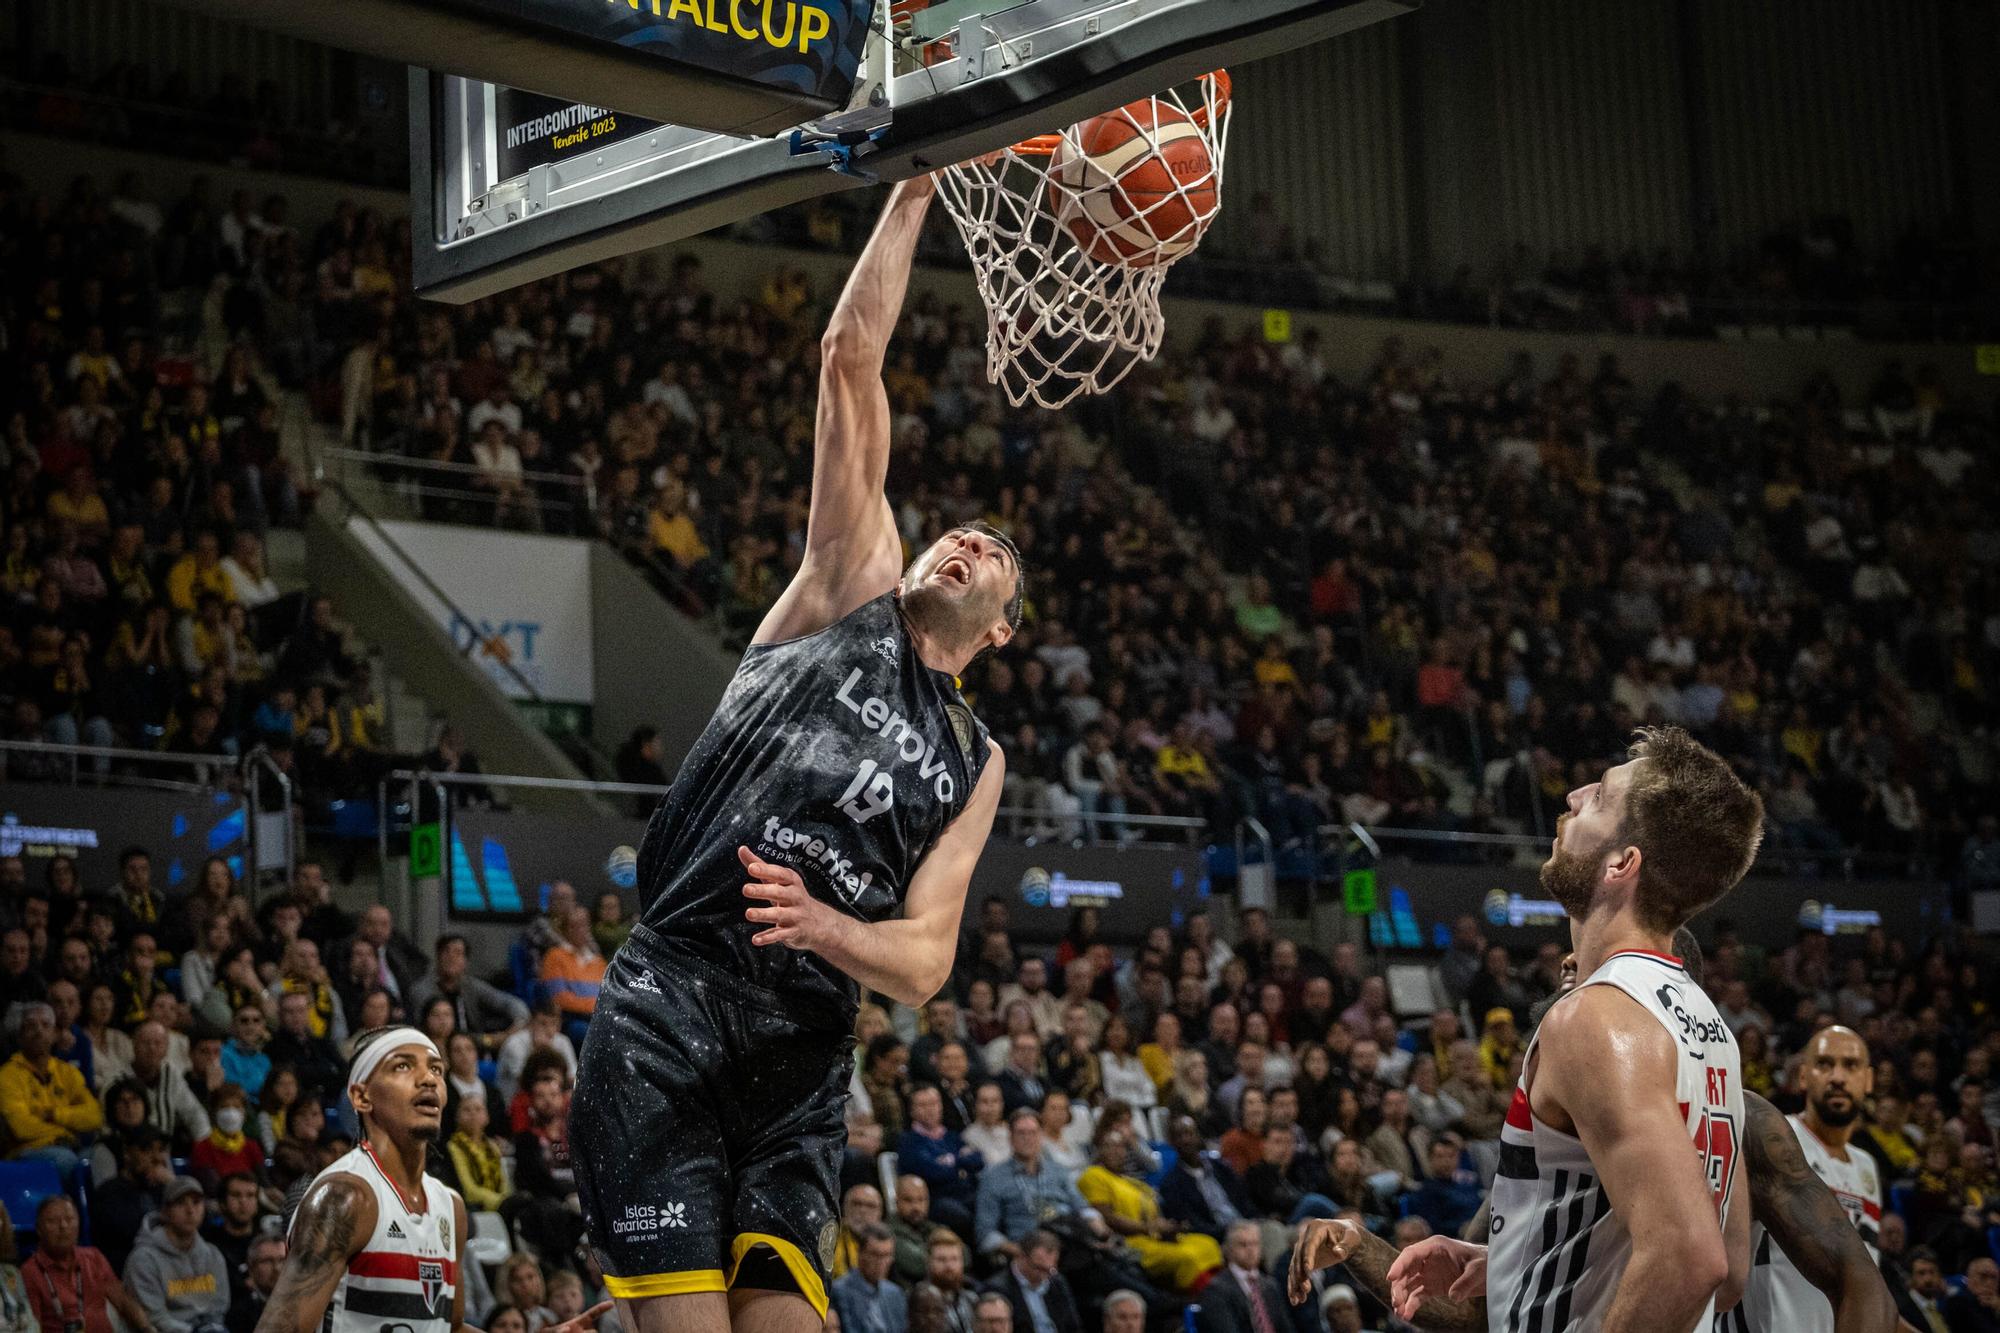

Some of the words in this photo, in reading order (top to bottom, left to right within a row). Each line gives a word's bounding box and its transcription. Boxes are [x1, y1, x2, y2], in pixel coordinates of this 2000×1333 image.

[552, 127, 589, 151] Tenerife
[591, 116, 617, 137] 2023
[835, 666, 954, 803] Lenovo
[833, 759, 893, 823] 19
[612, 1217, 658, 1234] Canarias
[625, 1205, 657, 1229] Islas
[420, 1265, 442, 1278] SPFC
